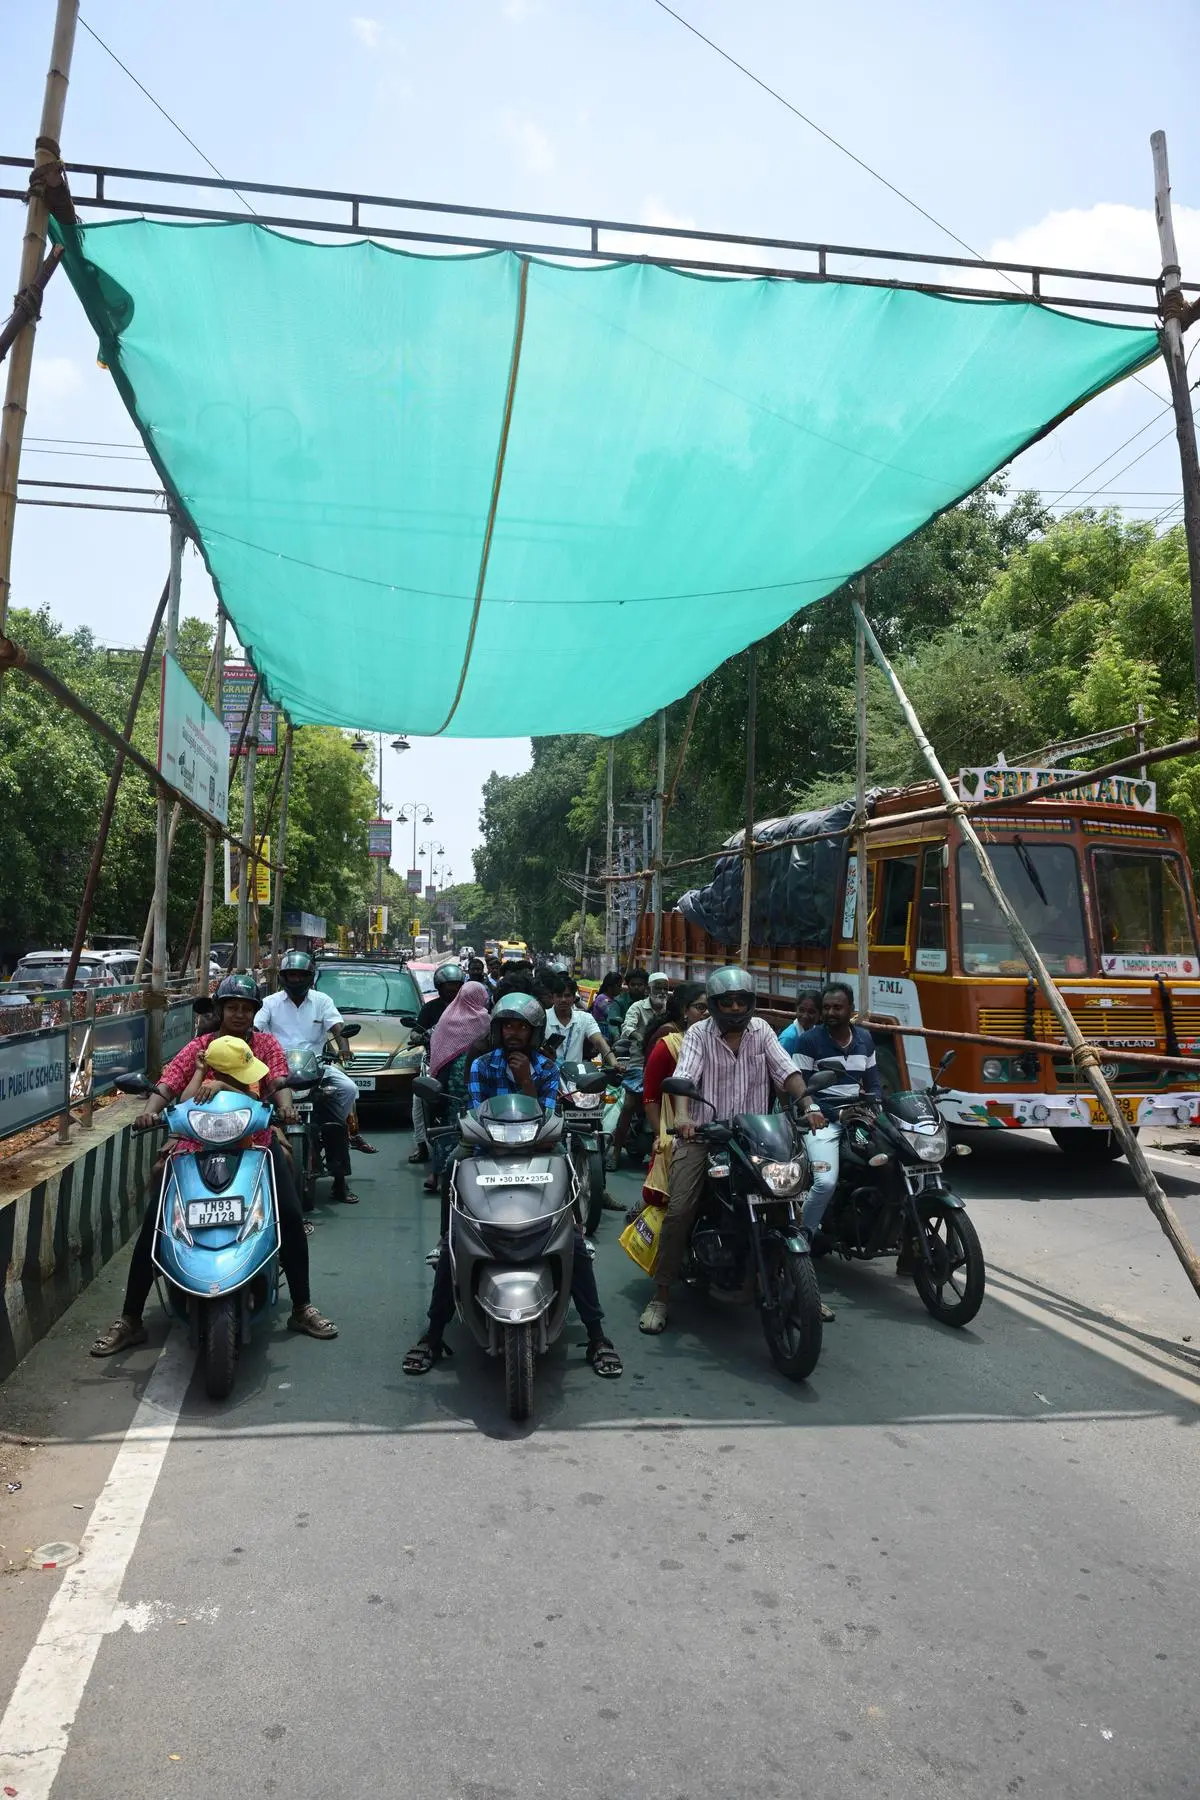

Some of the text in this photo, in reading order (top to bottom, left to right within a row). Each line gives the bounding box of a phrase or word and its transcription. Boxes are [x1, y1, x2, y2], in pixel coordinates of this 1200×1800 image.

[223, 685, 253, 693] GRAND
[983, 770, 1033, 799] SRI
[878, 980, 903, 994] TML
[1107, 1039, 1156, 1048] LEYLAND
[8, 1070, 34, 1099] PUBLIC
[35, 1061, 64, 1092] SCHOOL
[1095, 1099, 1131, 1110] T29
[204, 1200, 232, 1212] TN93
[199, 1211, 235, 1224] H7128
